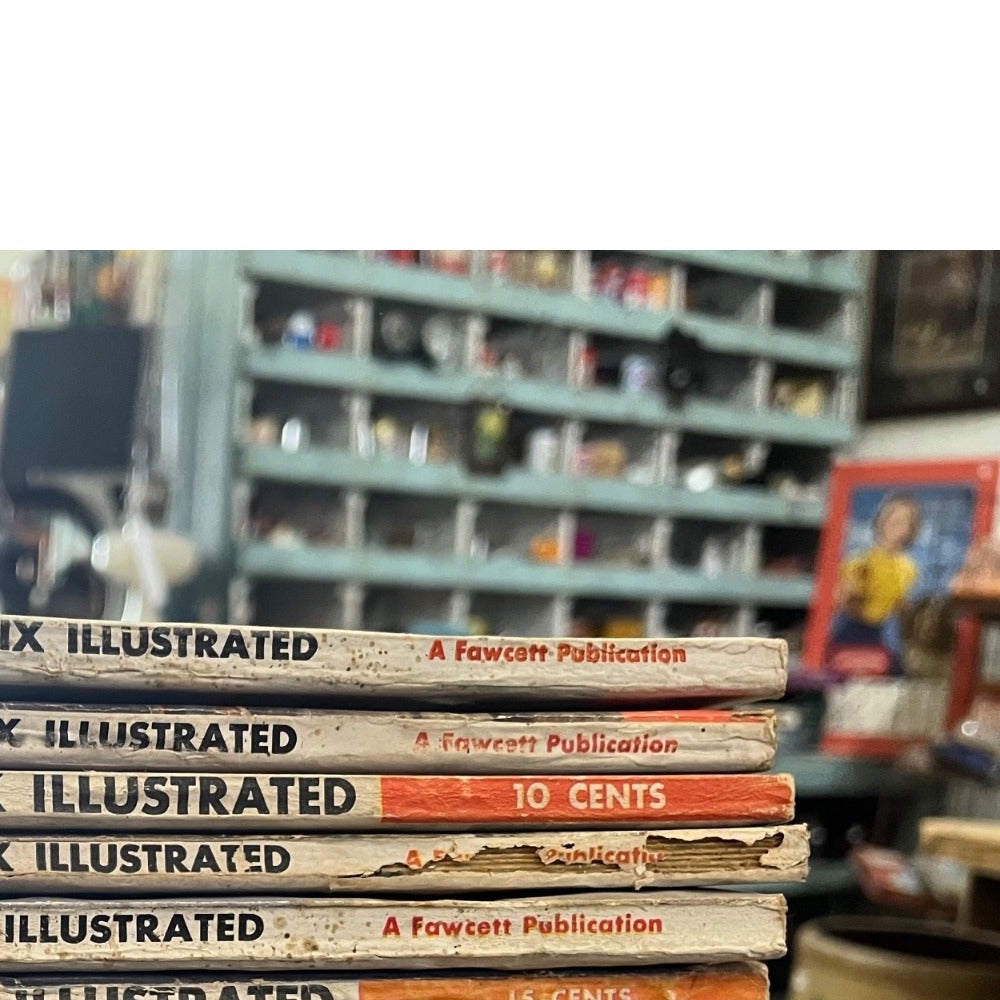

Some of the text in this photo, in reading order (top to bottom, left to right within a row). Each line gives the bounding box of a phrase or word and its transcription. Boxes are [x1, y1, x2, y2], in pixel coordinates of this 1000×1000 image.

[67, 623, 318, 661] ILLUSTRATED
[429, 640, 686, 663] A Fawcett Publication
[45, 720, 297, 754] ILLUSTRATED
[415, 732, 678, 754] A Fawcett Publication
[33, 773, 357, 816] ILLUSTRATED
[513, 783, 666, 810] 10 CENTS
[36, 843, 291, 873] ILLUSTRATED
[5, 913, 265, 944] ILLUSTRATED
[383, 913, 663, 936] A Fawcett Publication
